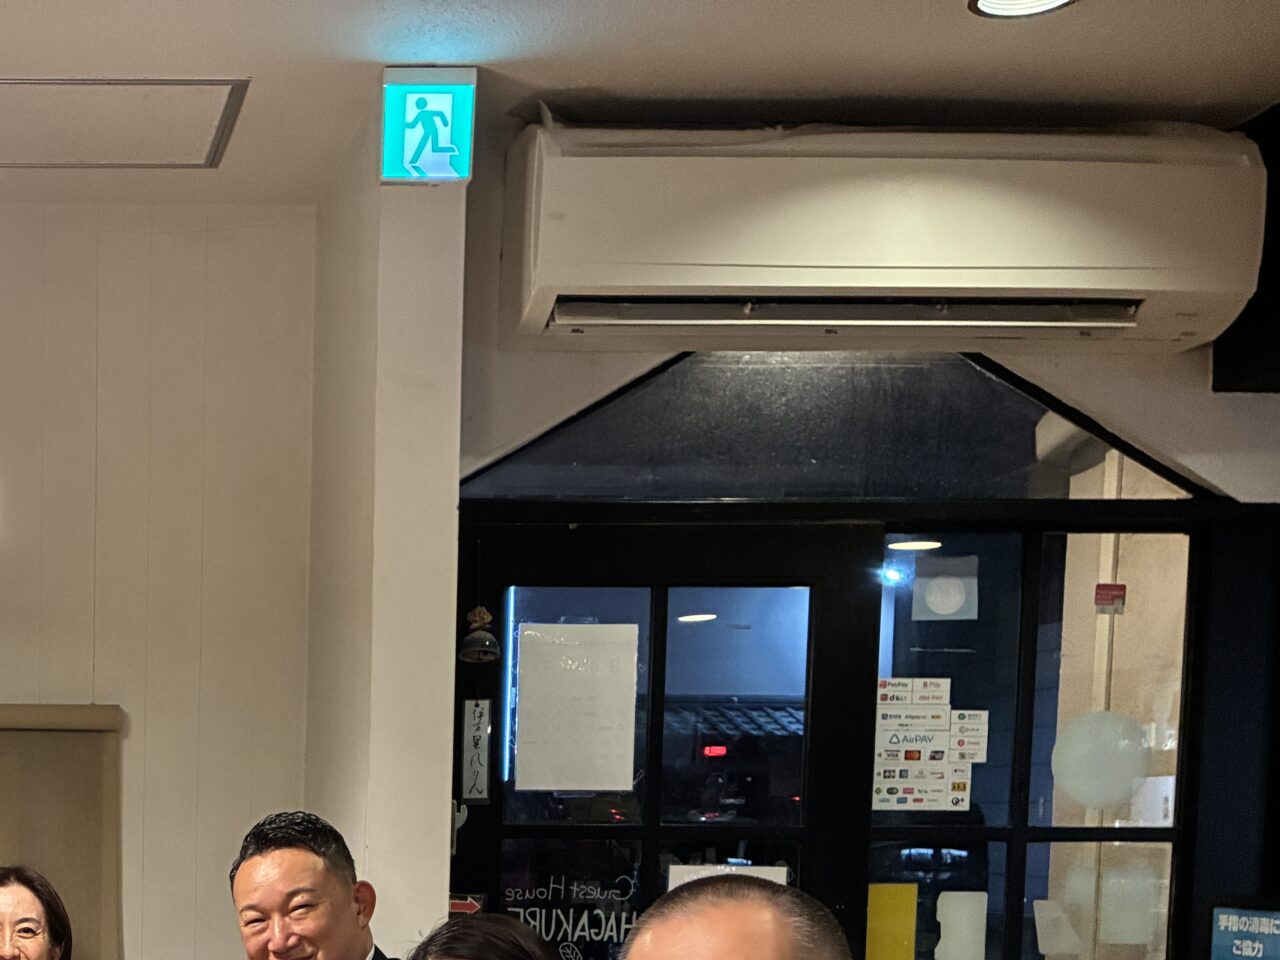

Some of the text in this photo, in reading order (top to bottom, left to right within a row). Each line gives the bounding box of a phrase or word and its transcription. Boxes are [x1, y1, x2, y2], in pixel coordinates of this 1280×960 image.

[902, 735, 934, 744] AirPAY
[1218, 914, 1280, 934] 手指の消毒に
[1232, 939, 1264, 958] ご協力
